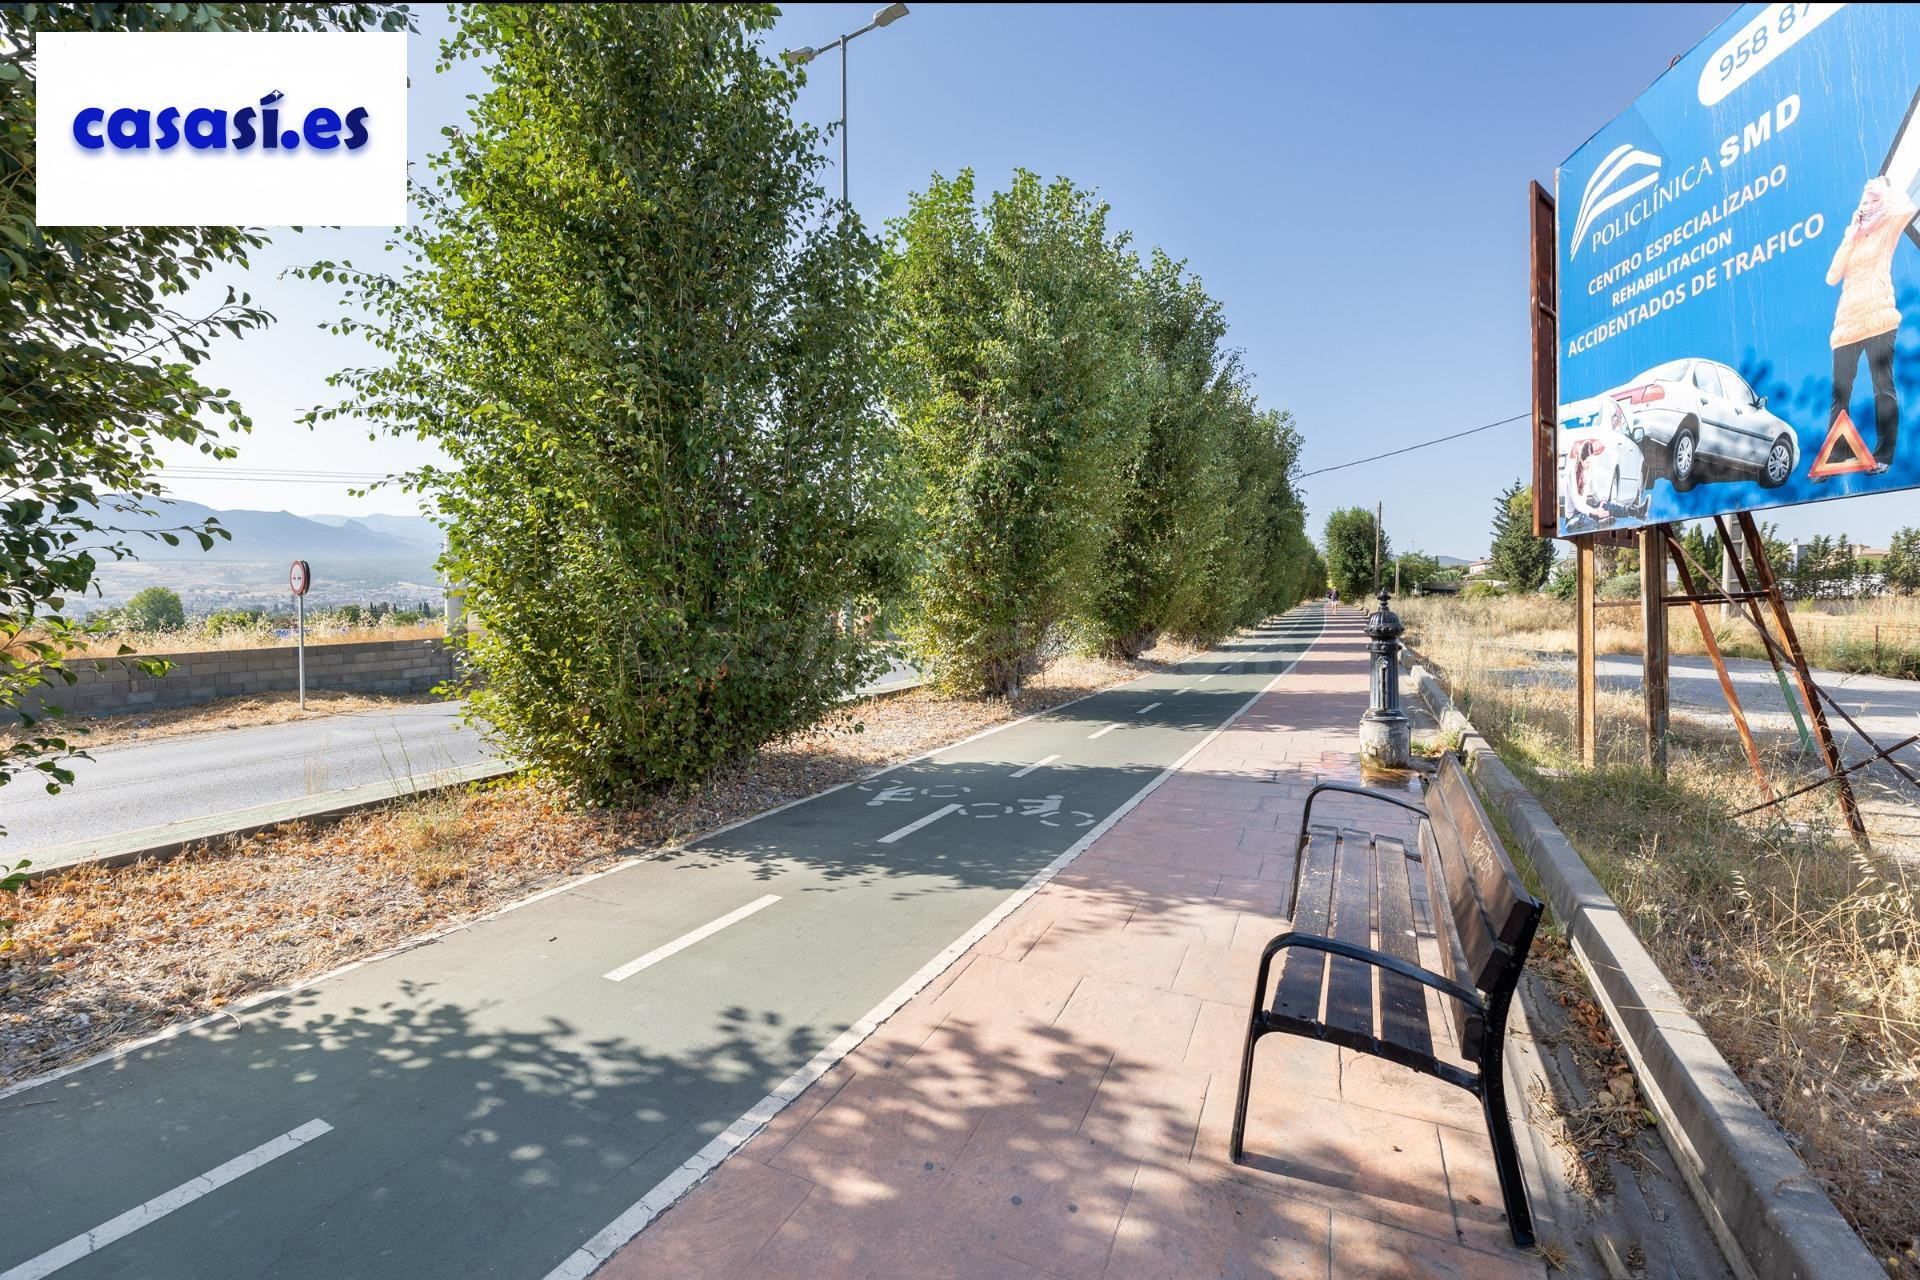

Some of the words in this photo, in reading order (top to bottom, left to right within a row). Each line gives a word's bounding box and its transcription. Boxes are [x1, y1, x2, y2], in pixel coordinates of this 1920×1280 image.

[1719, 26, 1768, 81] 958
[1588, 252, 1642, 296] CENTRO
[1645, 164, 1787, 262] ESPECIALIZADO
[1592, 157, 1713, 252] POLICLÍNICA
[1719, 94, 1800, 168] SMD
[1568, 283, 1686, 358] ACCIDENTADOS
[1691, 265, 1717, 297] DE
[1721, 213, 1824, 280] TRAFICO
[1612, 228, 1732, 307] REHABILITACION
